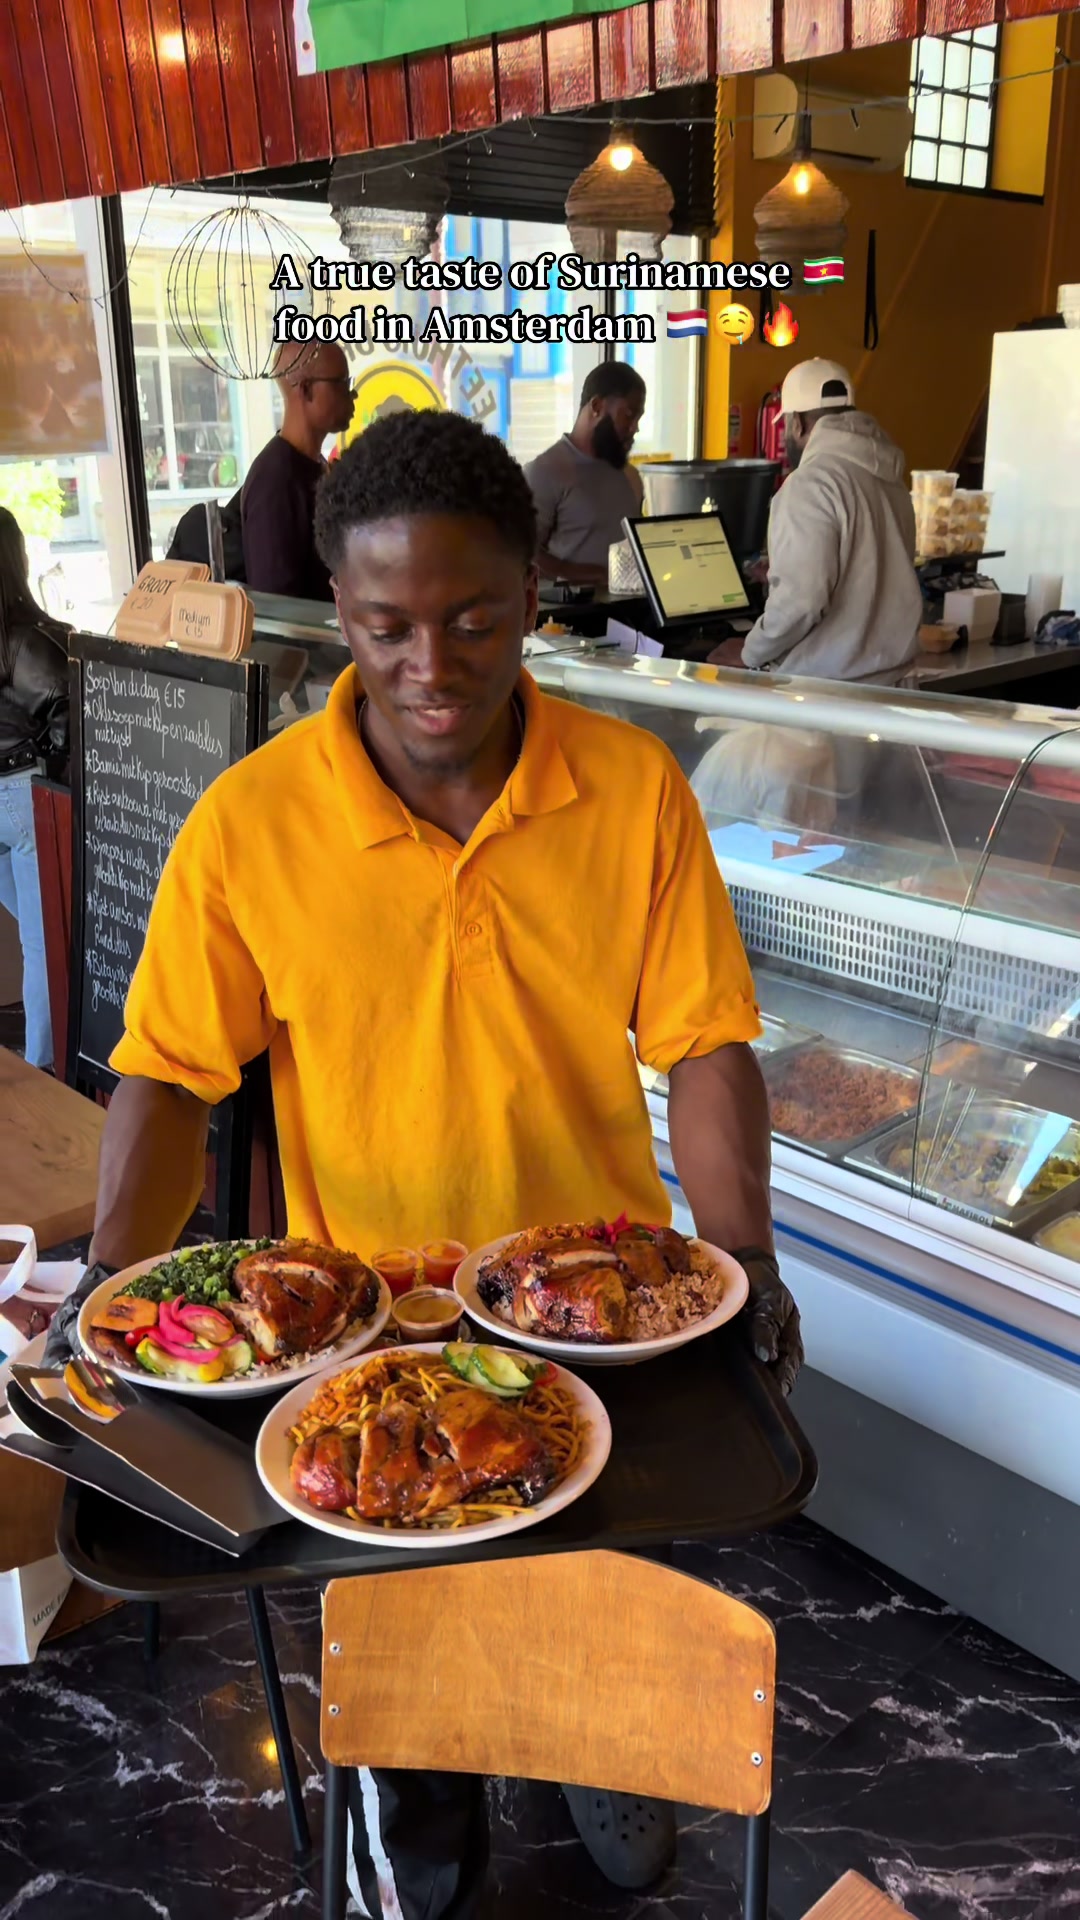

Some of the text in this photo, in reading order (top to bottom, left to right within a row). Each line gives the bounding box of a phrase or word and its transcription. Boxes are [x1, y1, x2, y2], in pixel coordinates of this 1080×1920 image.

[138, 575, 176, 595] GROOT
[85, 661, 110, 706] Soep
[140, 673, 161, 714] dag
[164, 681, 186, 709] €15
